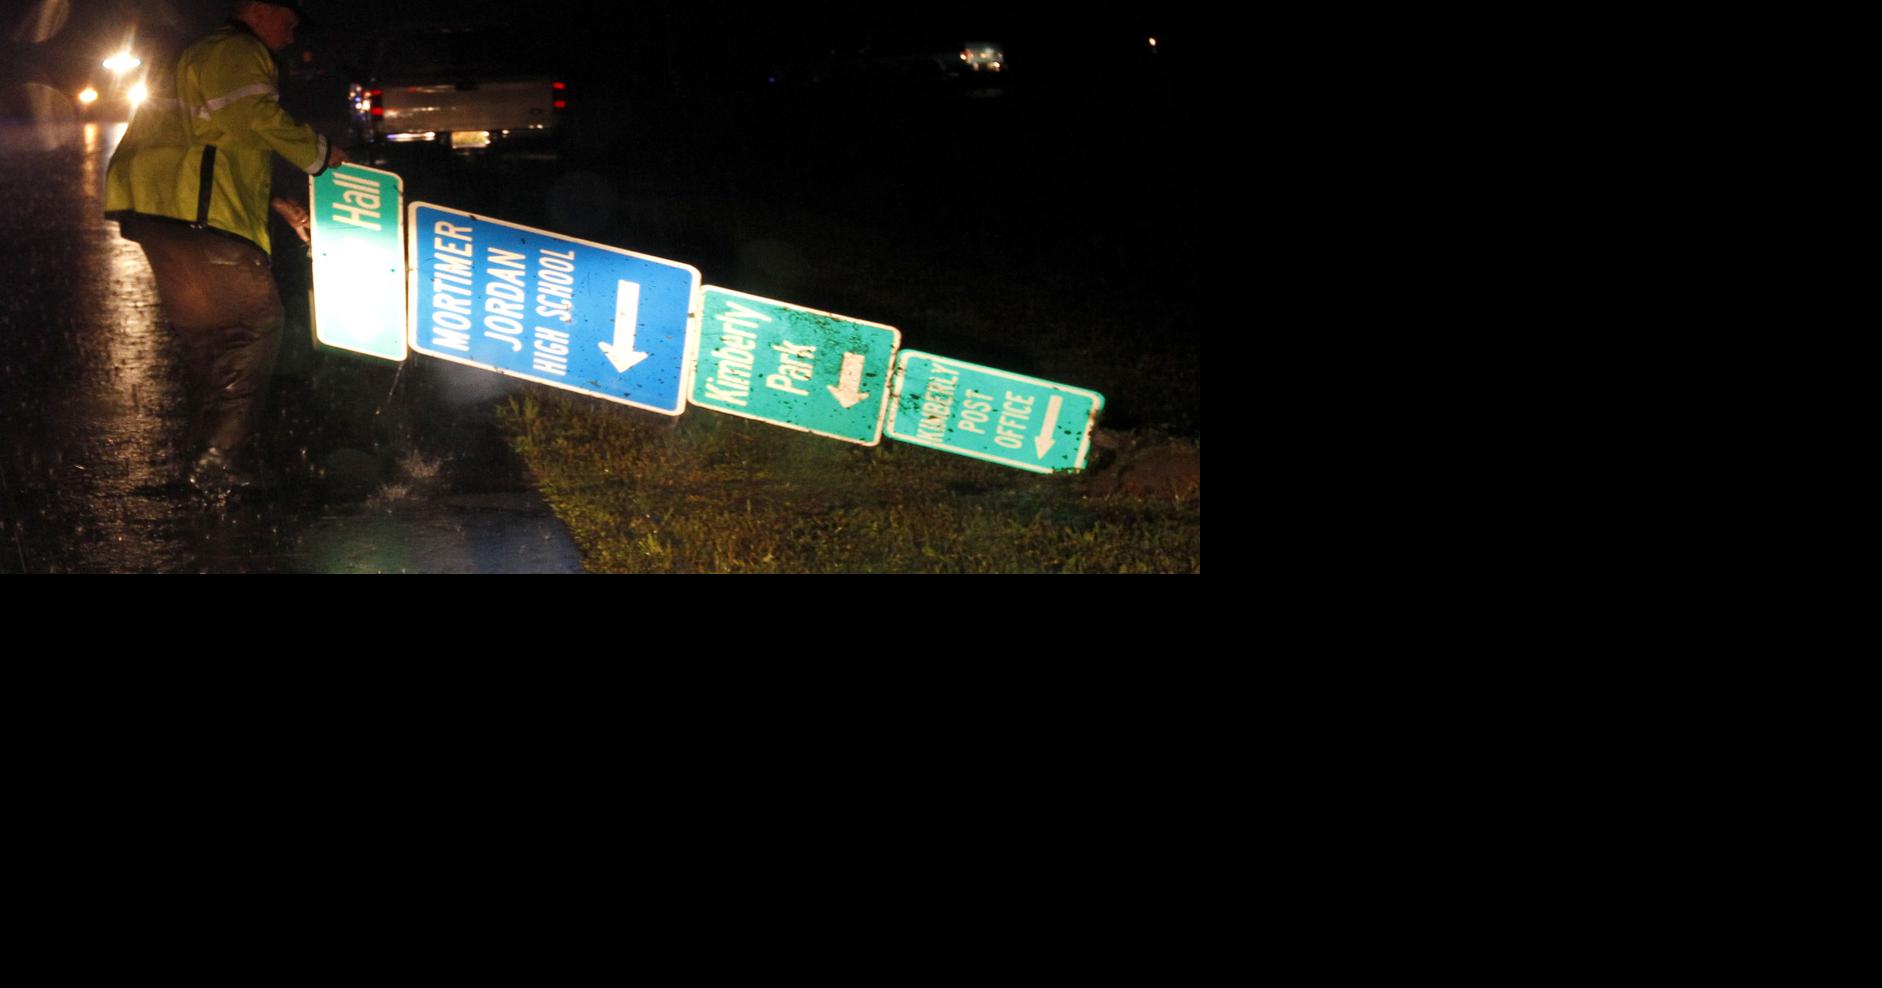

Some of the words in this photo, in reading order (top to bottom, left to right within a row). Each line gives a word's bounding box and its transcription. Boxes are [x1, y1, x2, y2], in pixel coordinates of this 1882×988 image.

[332, 172, 381, 231] Hall
[432, 220, 473, 352] MORTIMER
[484, 247, 527, 352] JORDAN
[535, 249, 575, 323] SCHOOL
[533, 326, 570, 376] HIGH
[705, 301, 772, 406] Kimberly
[765, 341, 817, 395] Park
[917, 362, 960, 443] KIMBERLY
[959, 389, 994, 435] POST
[994, 391, 1035, 449] OFFICE
